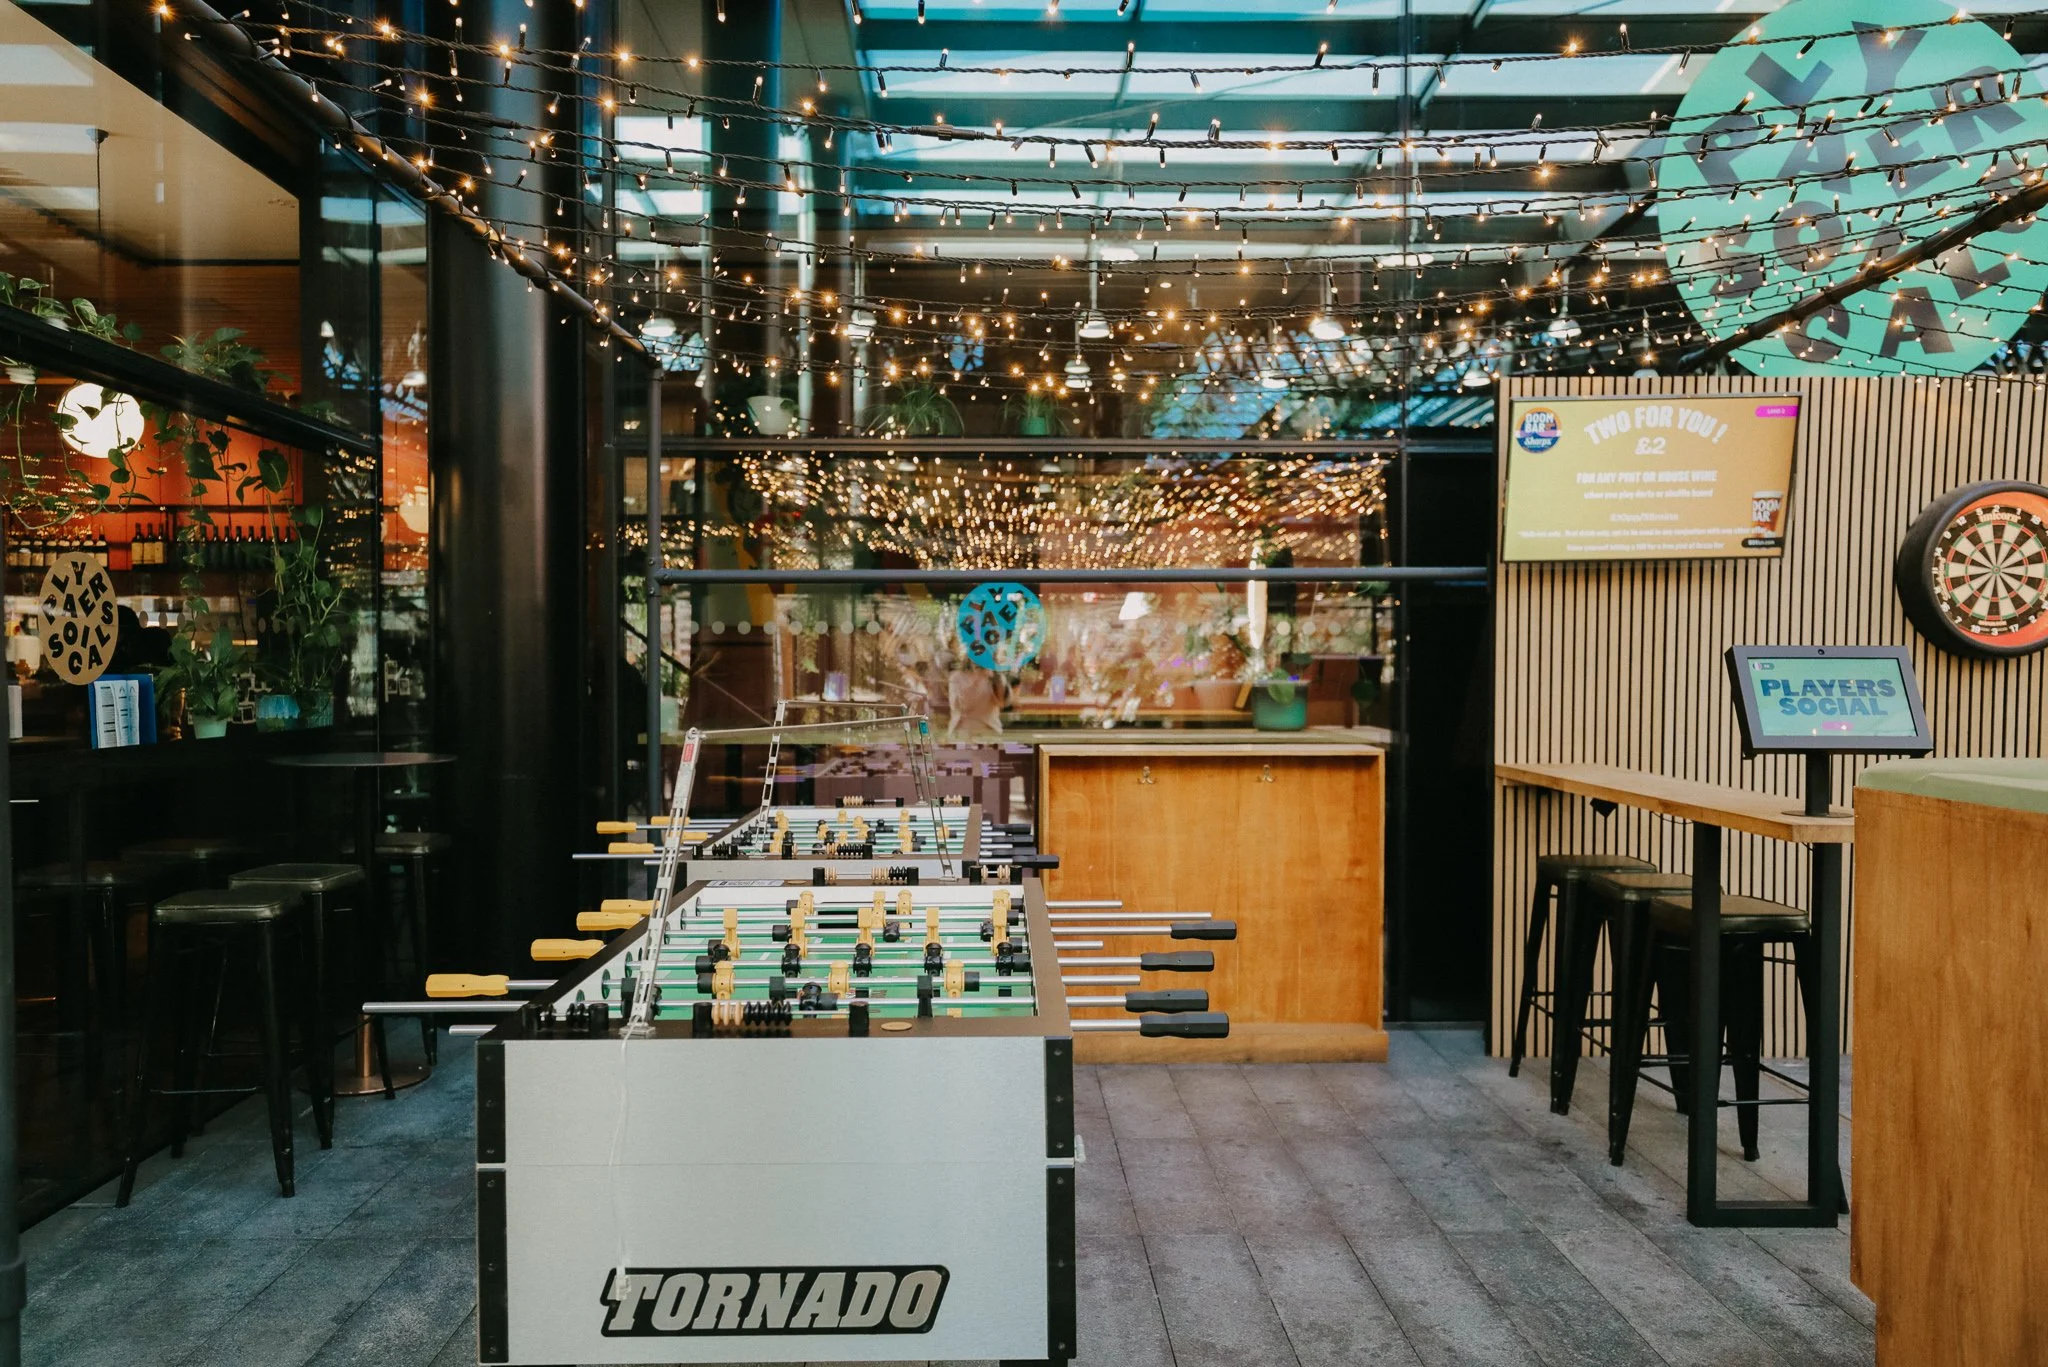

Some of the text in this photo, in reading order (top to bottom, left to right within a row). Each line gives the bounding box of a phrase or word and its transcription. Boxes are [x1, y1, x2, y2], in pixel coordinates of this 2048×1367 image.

[1525, 412, 1555, 424] DOOM
[1584, 410, 1631, 445] TWO
[1634, 405, 1674, 429] FOR
[1525, 423, 1546, 433] BAR
[1635, 436, 1666, 455] £2
[1760, 678, 1897, 697] PLAYERS
[1778, 697, 1889, 716] SOCIAL
[606, 1269, 943, 1332] TORNADO
